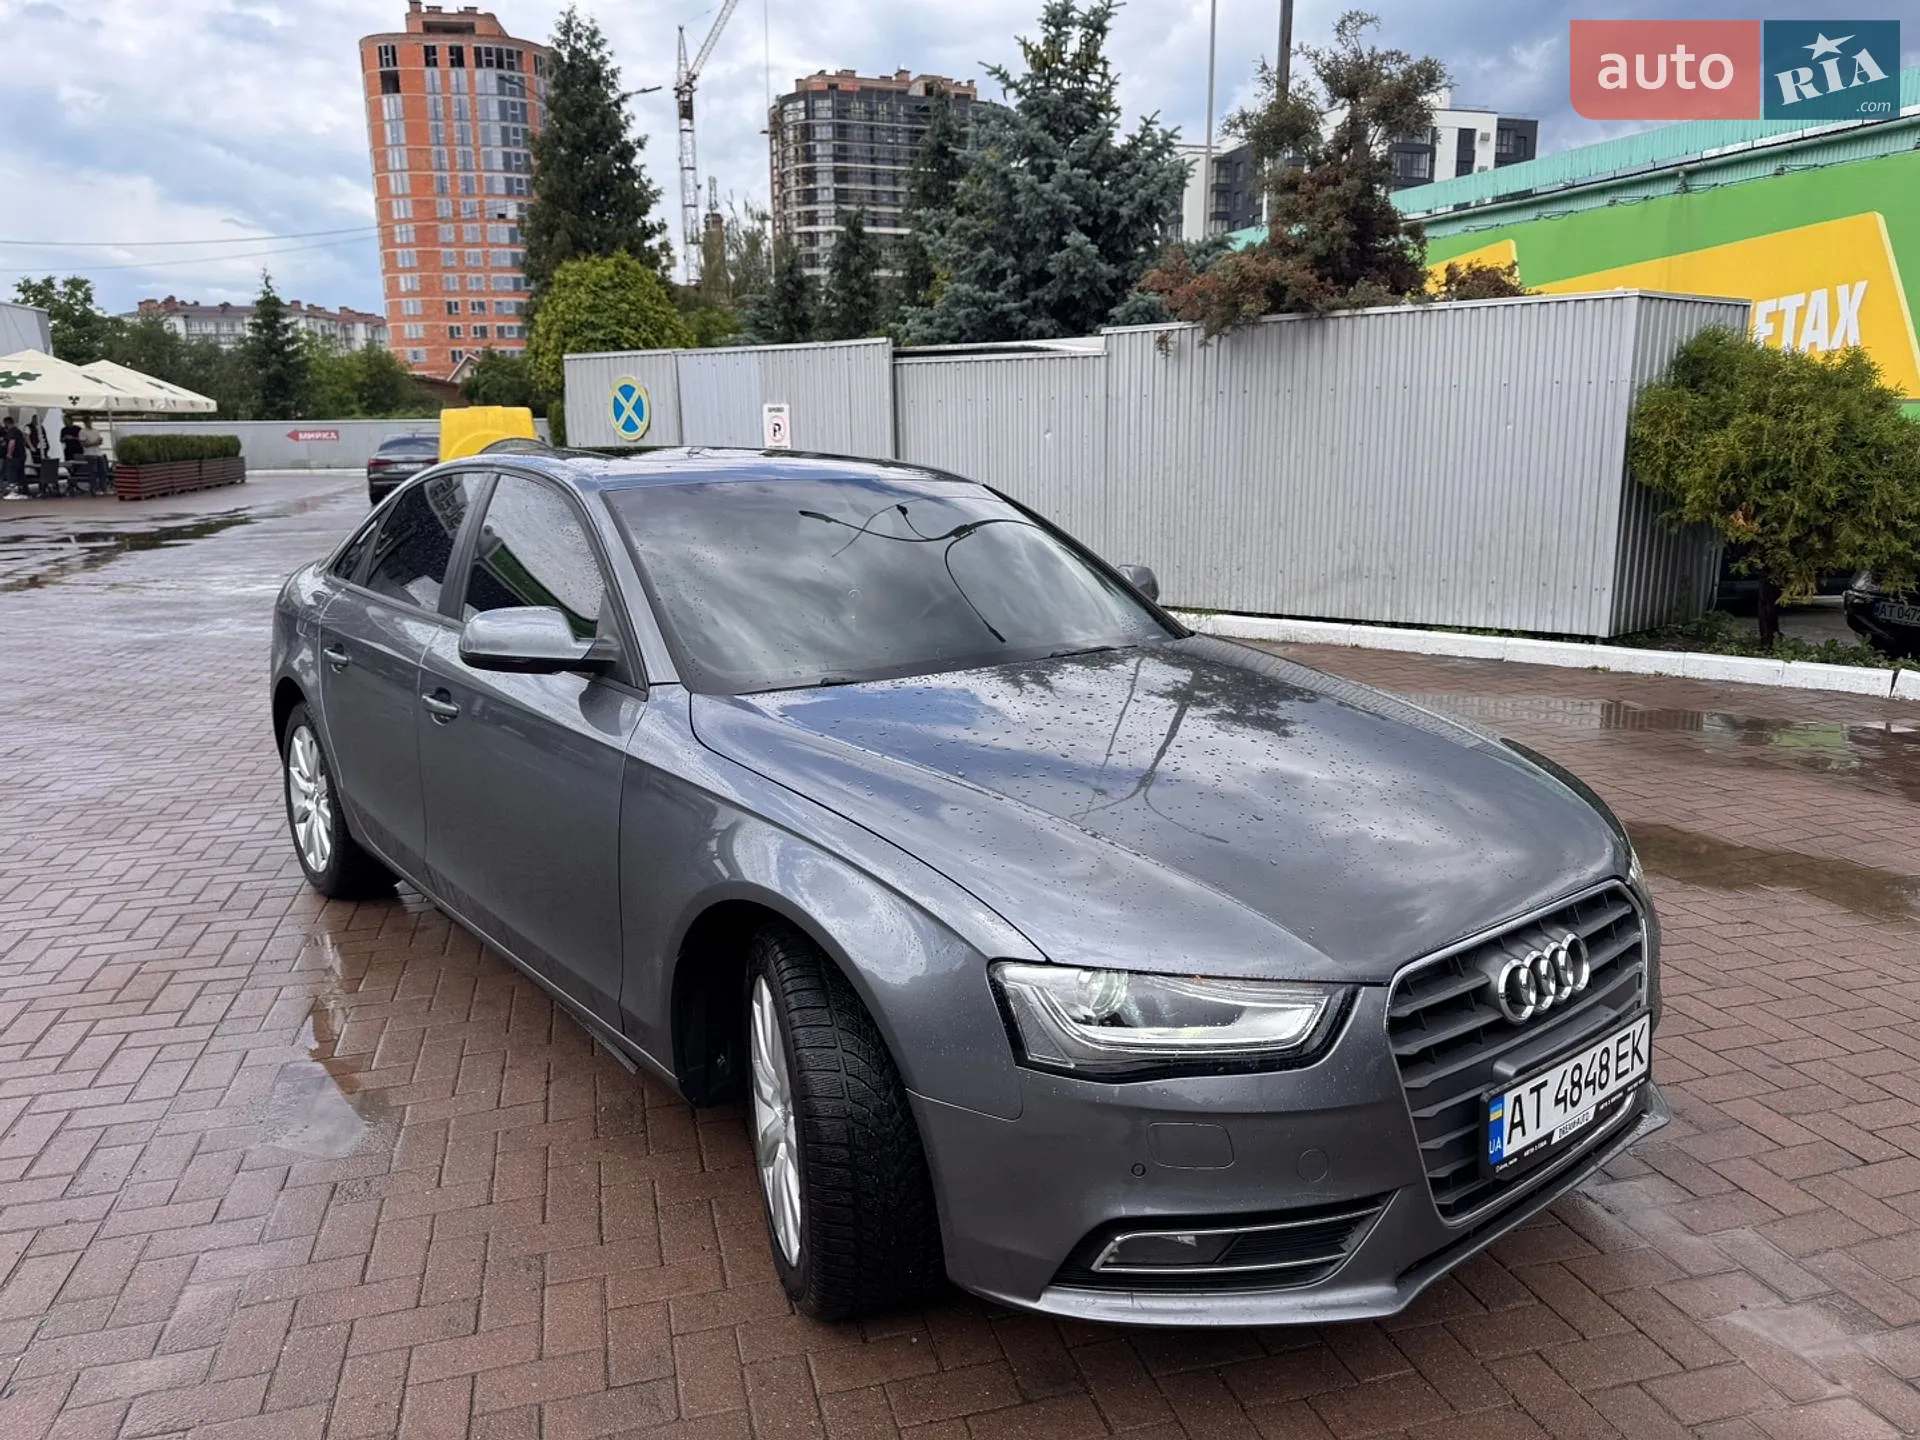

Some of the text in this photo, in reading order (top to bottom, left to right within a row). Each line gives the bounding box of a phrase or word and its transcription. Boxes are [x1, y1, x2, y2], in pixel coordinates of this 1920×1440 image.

[1507, 1022, 1646, 1145] AT 4848 EK
[1489, 1135, 1503, 1154] UA
